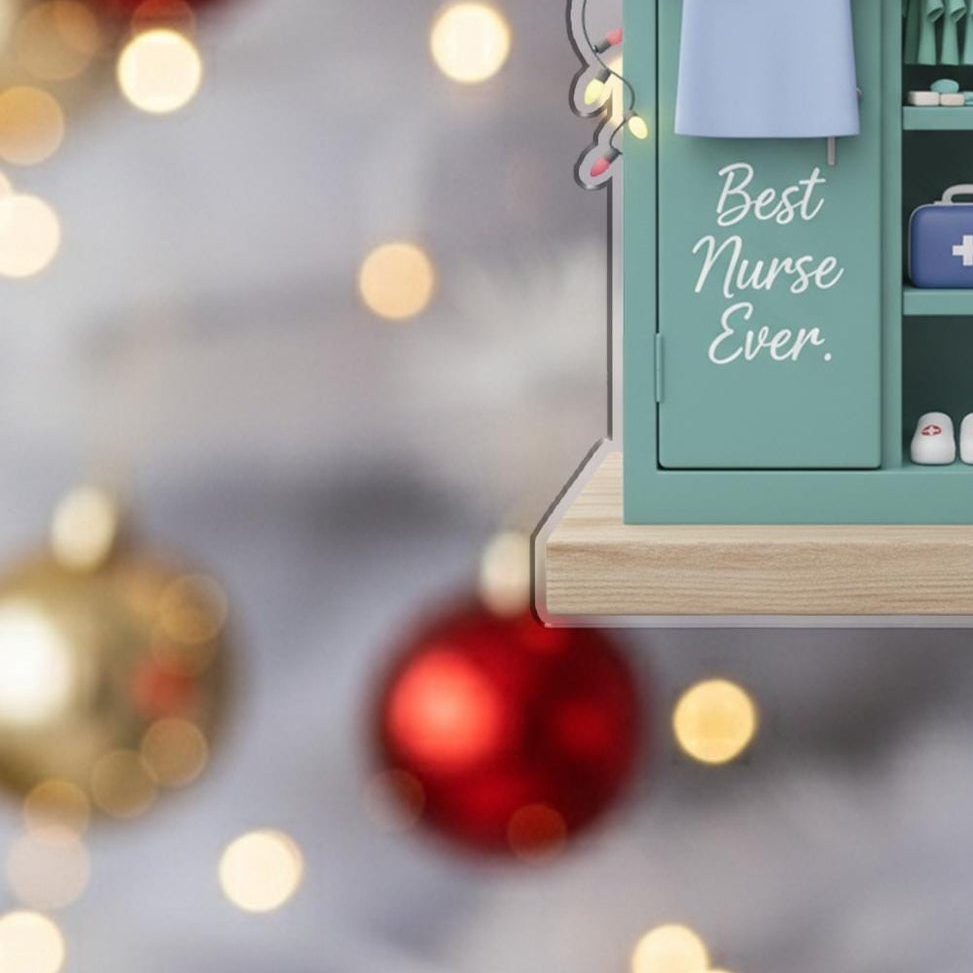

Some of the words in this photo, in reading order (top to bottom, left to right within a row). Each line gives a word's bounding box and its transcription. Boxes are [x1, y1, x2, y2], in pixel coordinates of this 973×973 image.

[716, 162, 826, 226] Best
[692, 235, 844, 298] Nurse
[708, 302, 832, 364] Ever.
